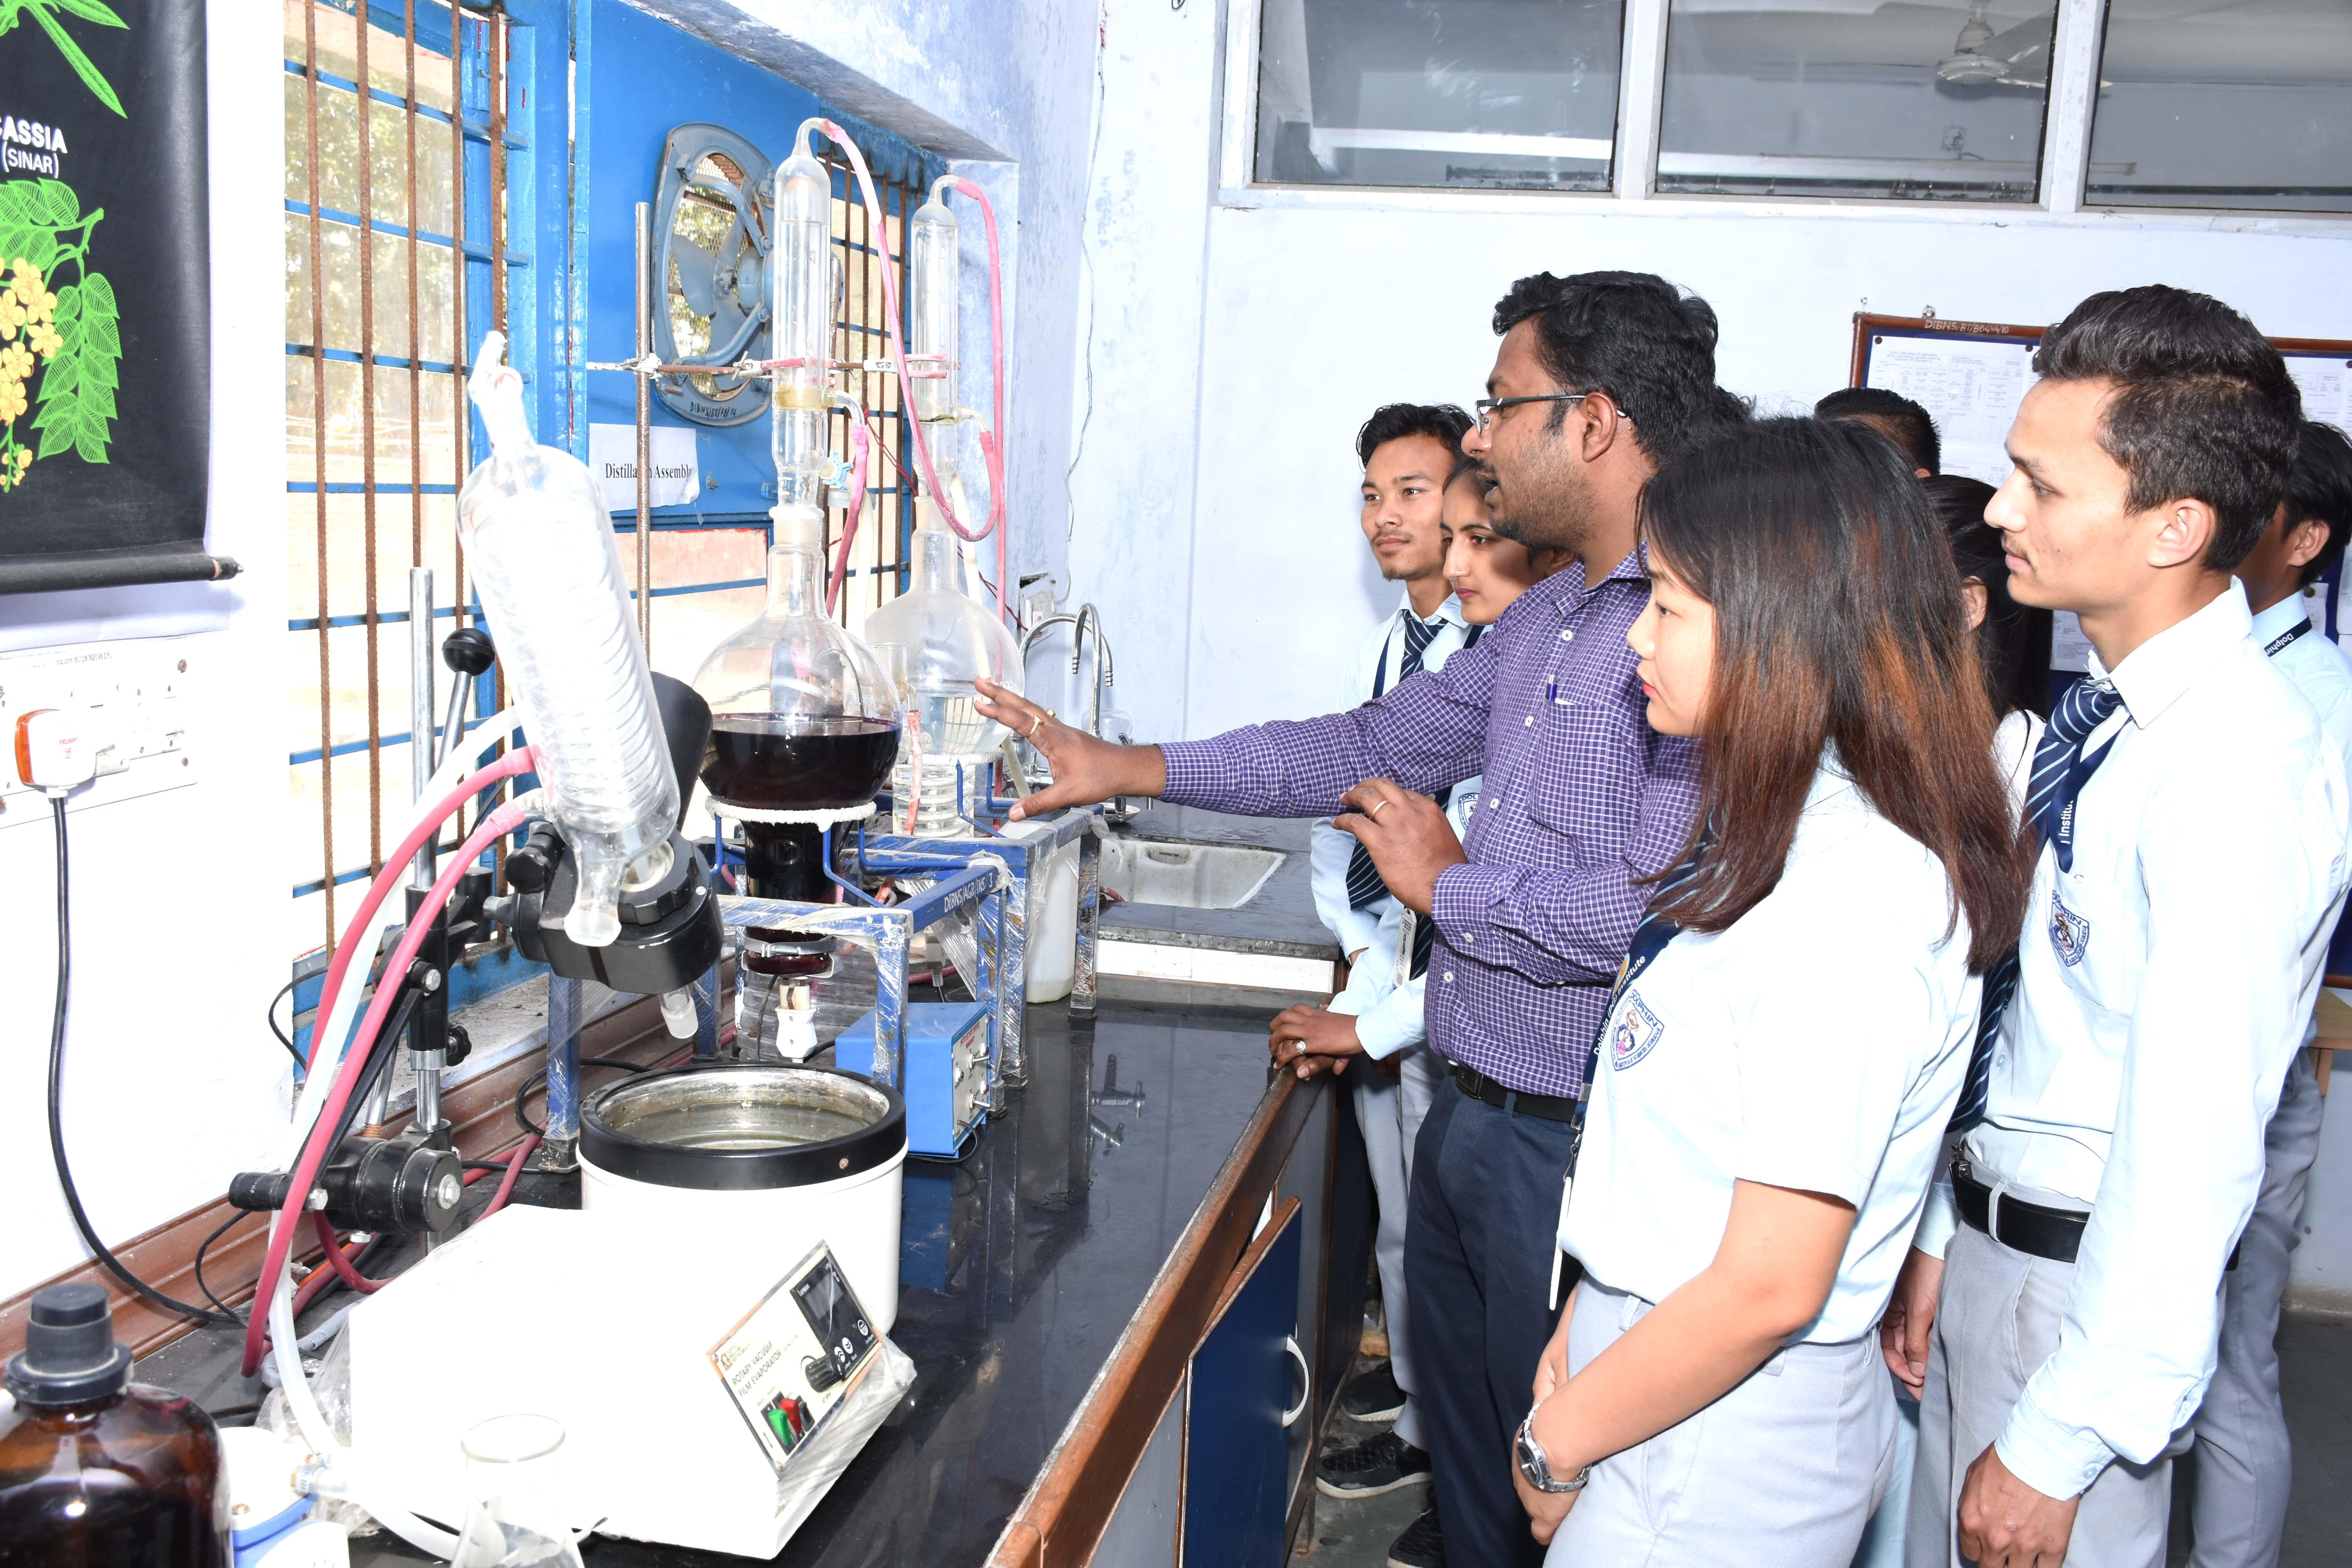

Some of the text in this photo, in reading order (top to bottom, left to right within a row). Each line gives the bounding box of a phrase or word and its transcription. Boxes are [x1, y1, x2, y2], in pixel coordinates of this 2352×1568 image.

[0, 116, 68, 154] ASSIA
[2, 140, 59, 179] (SINAR)
[605, 463, 693, 482] Distillan Assembly
[2266, 633, 2294, 655] Dolphin
[997, 681, 1013, 690] 000
[2058, 800, 2073, 837] Institu
[1593, 1018, 1609, 1056] Dolphin
[1608, 995, 1617, 1018] (PG)
[1617, 956, 1646, 995] Institute
[1629, 992, 1658, 1028] DOLPHIN
[731, 1363, 752, 1386] ROTARY
[751, 1341, 772, 1366] VACUUM
[739, 1349, 782, 1398] FILM EVAPORATOR
